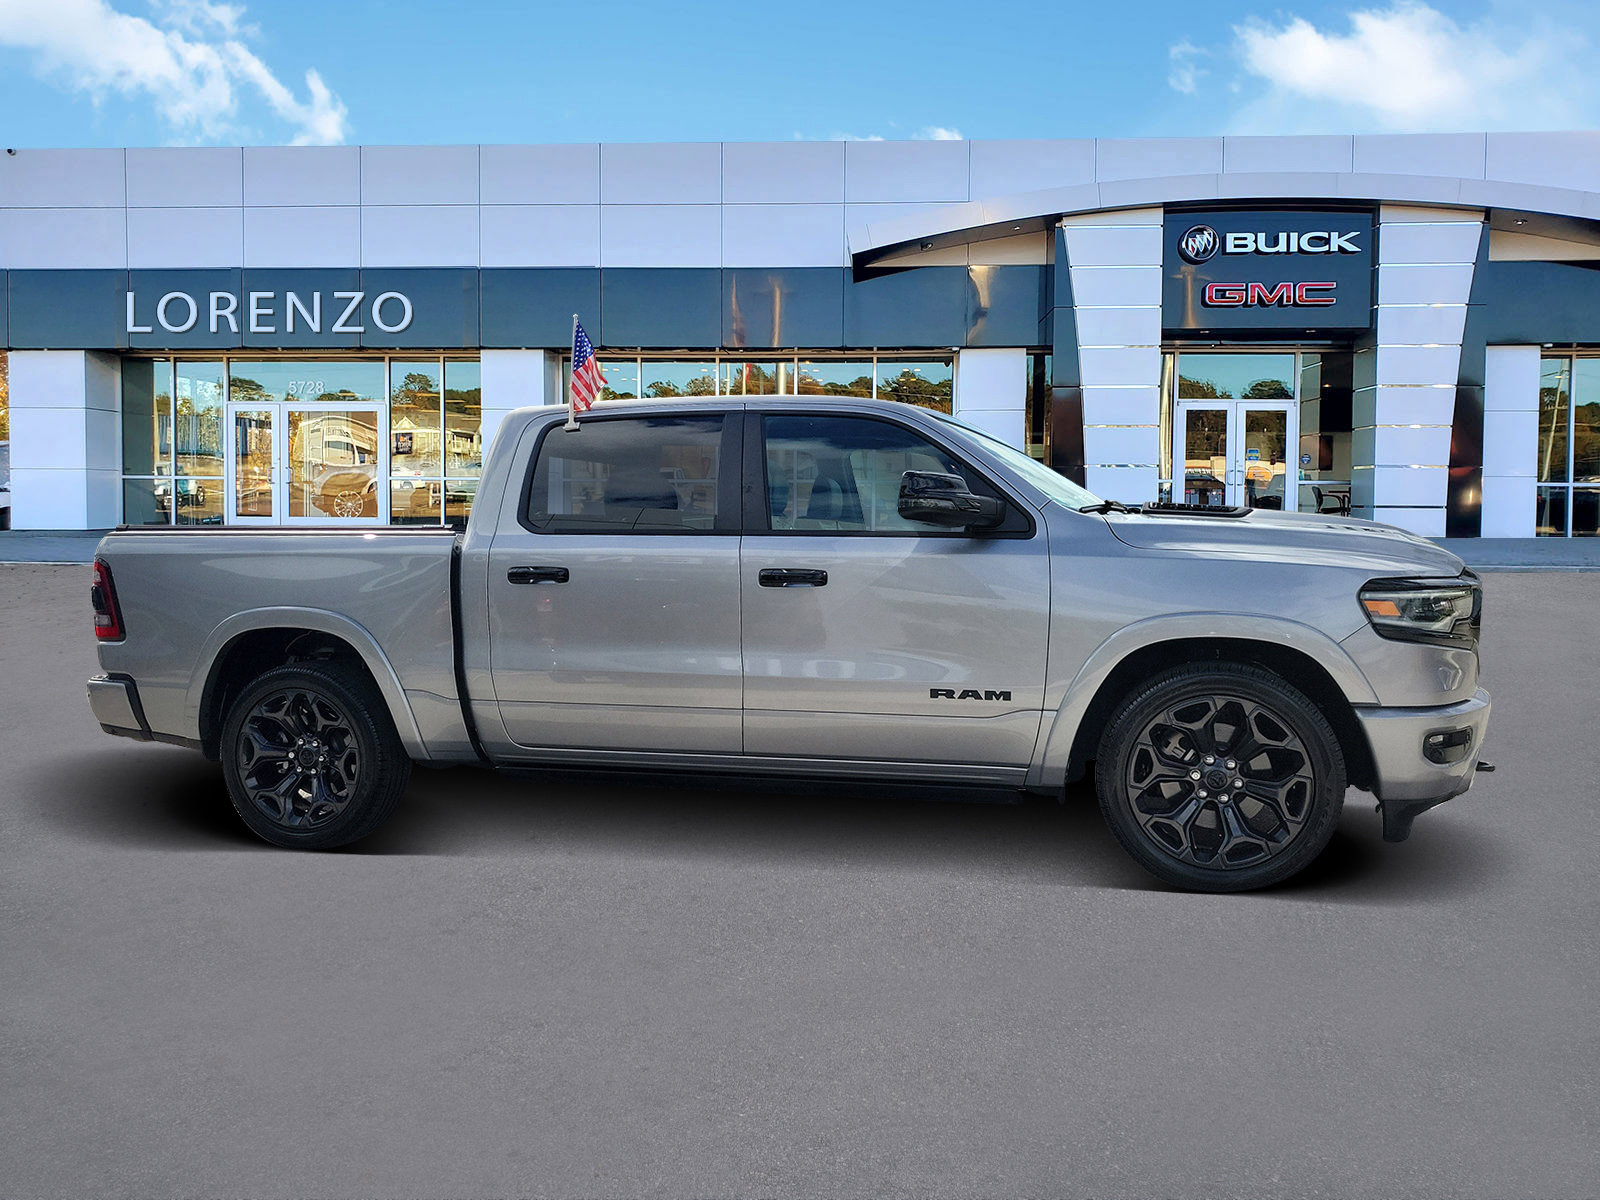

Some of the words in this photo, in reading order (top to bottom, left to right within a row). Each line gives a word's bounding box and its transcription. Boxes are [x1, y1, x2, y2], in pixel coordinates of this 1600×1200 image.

[1224, 231, 1362, 253] BUICK
[1204, 281, 1337, 306] GMC
[126, 291, 414, 333] LORENZO
[288, 380, 325, 394] 5728
[929, 688, 1012, 702] RAM
